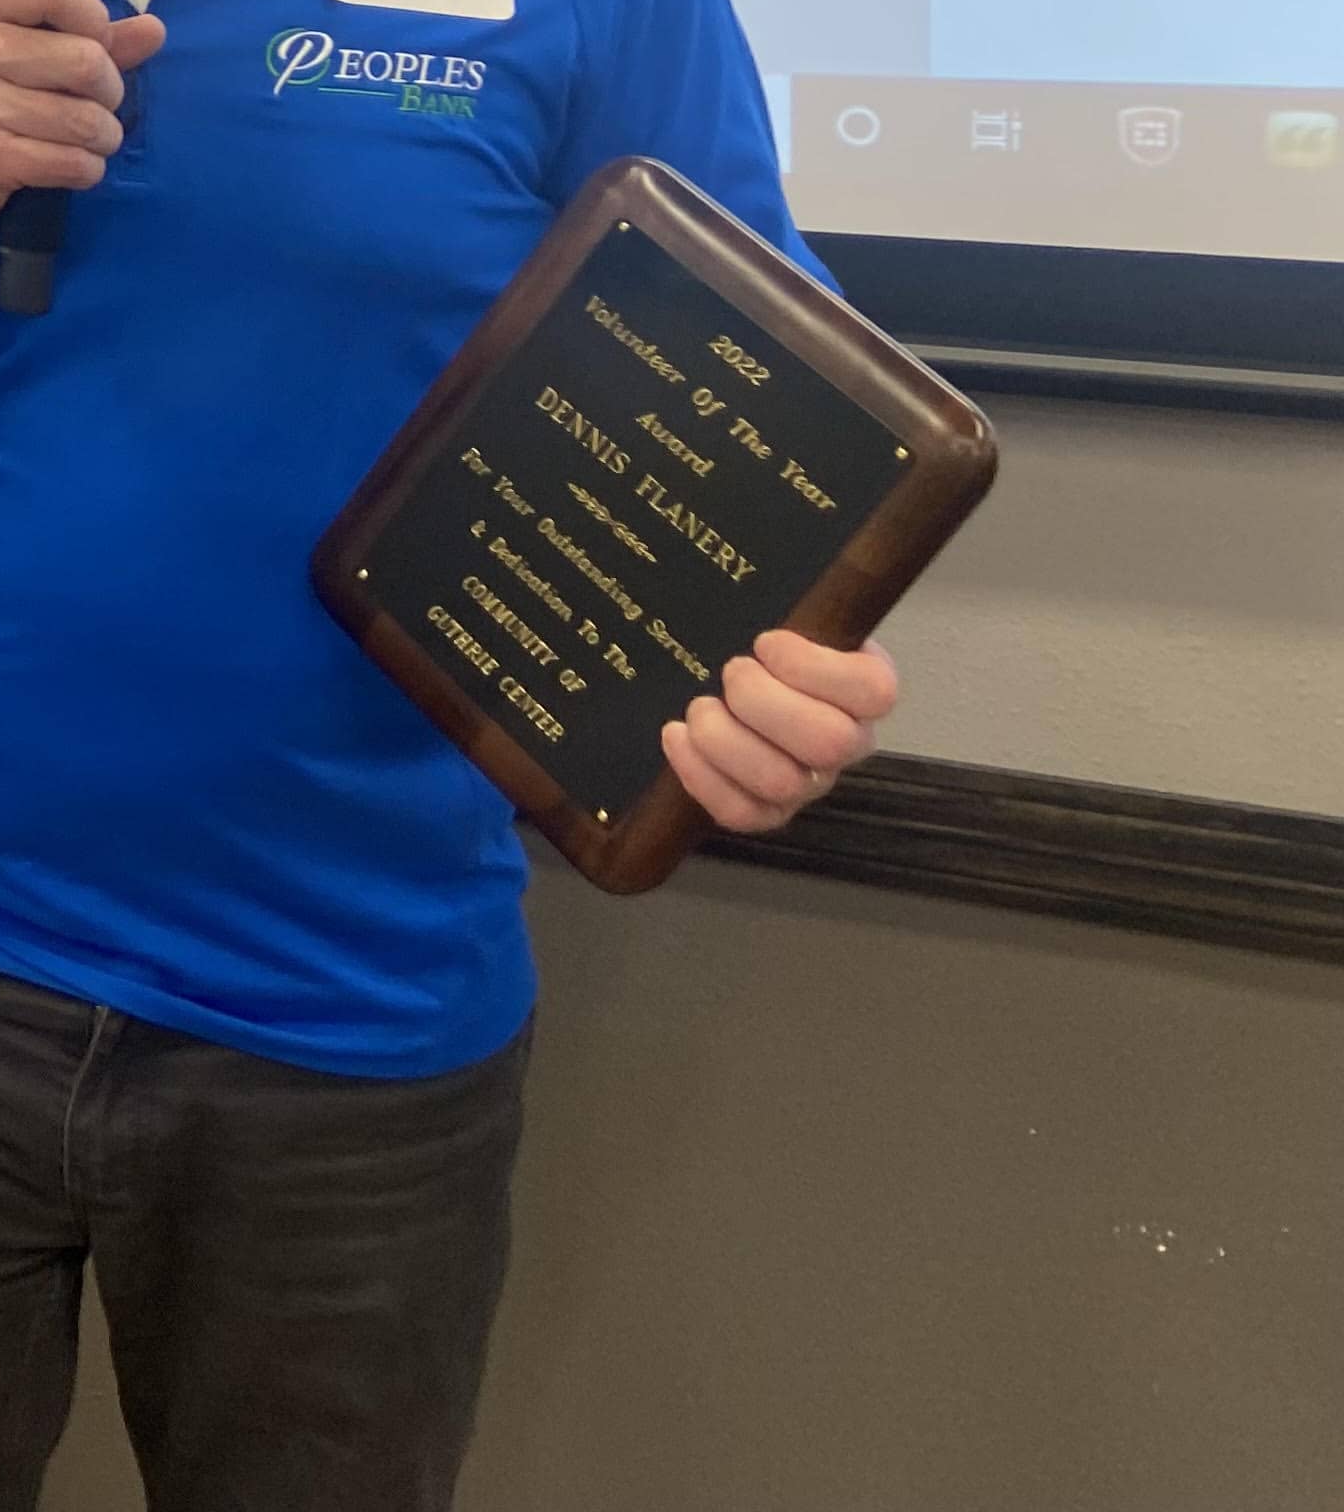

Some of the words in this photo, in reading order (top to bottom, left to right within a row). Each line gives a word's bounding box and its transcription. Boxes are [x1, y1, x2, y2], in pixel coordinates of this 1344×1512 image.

[273, 30, 487, 97] PEOPLES
[399, 84, 477, 119] BANK
[585, 295, 686, 383] Volunteer
[692, 388, 727, 416] Of
[729, 417, 773, 460] The
[780, 458, 837, 510] Year
[708, 335, 771, 386] 2022
[535, 386, 631, 474] DENNIS
[634, 473, 757, 582] FLANERY
[635, 413, 715, 477] Award
[462, 448, 492, 476] For
[494, 476, 536, 516] Your
[537, 517, 643, 621] Outstanding
[646, 619, 710, 681] Service
[488, 537, 573, 622] Dedication
[577, 618, 599, 645] To
[603, 643, 638, 680] The
[427, 605, 500, 676] GUTHRIE
[499, 676, 564, 742] CENTER
[463, 576, 560, 666] COMMUNITY
[560, 669, 587, 691] OF
